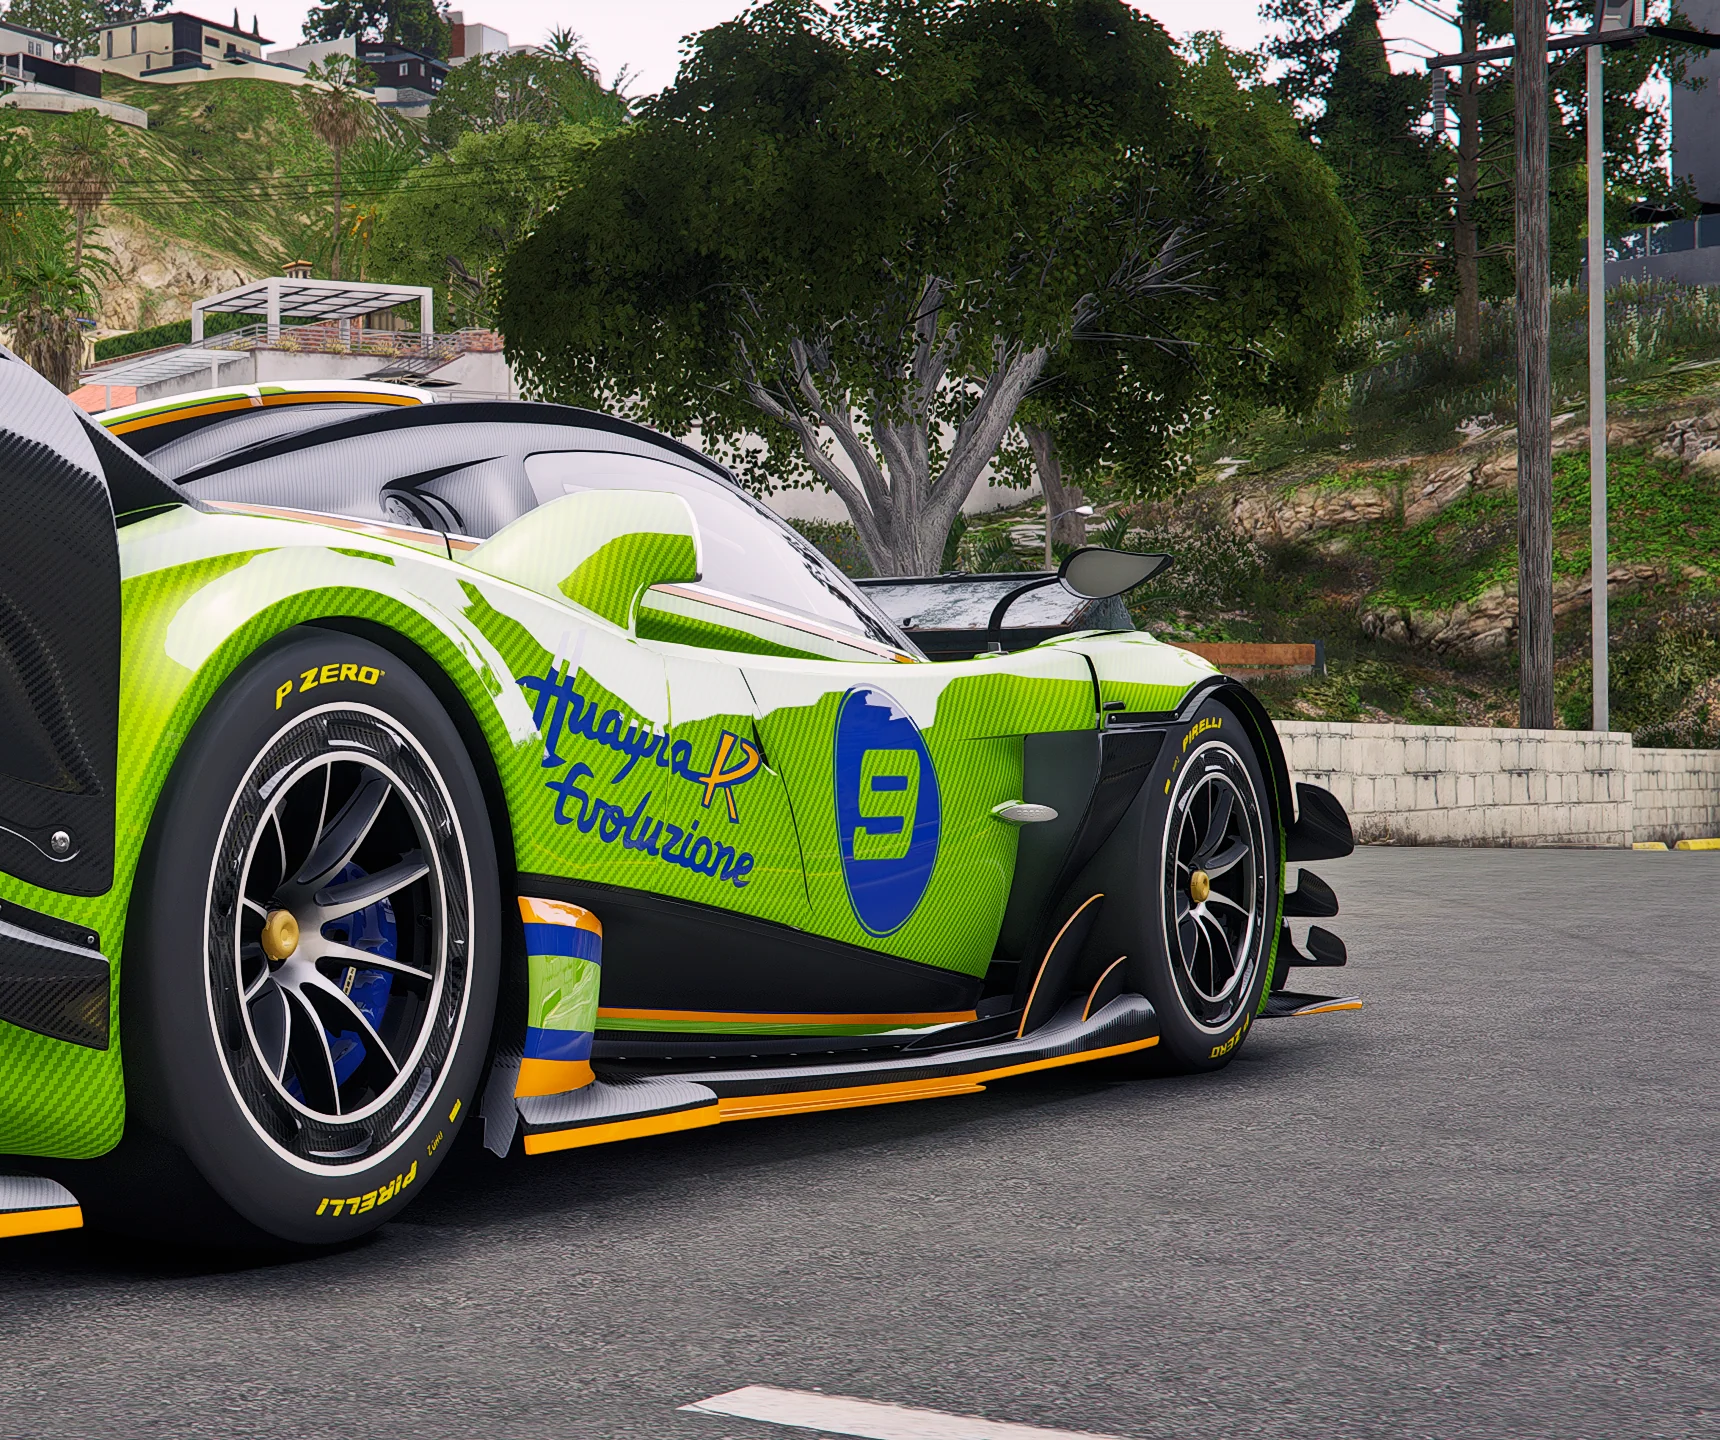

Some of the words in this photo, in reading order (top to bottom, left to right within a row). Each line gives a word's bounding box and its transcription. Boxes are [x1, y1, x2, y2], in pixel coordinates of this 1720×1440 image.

[275, 679, 293, 710] P
[515, 629, 696, 785] Huayra
[698, 728, 763, 824] R
[1182, 716, 1223, 753] PIRELLI
[544, 762, 755, 888] Evoluzione
[853, 749, 921, 861] 9
[315, 1159, 418, 1217] PIRELLI
